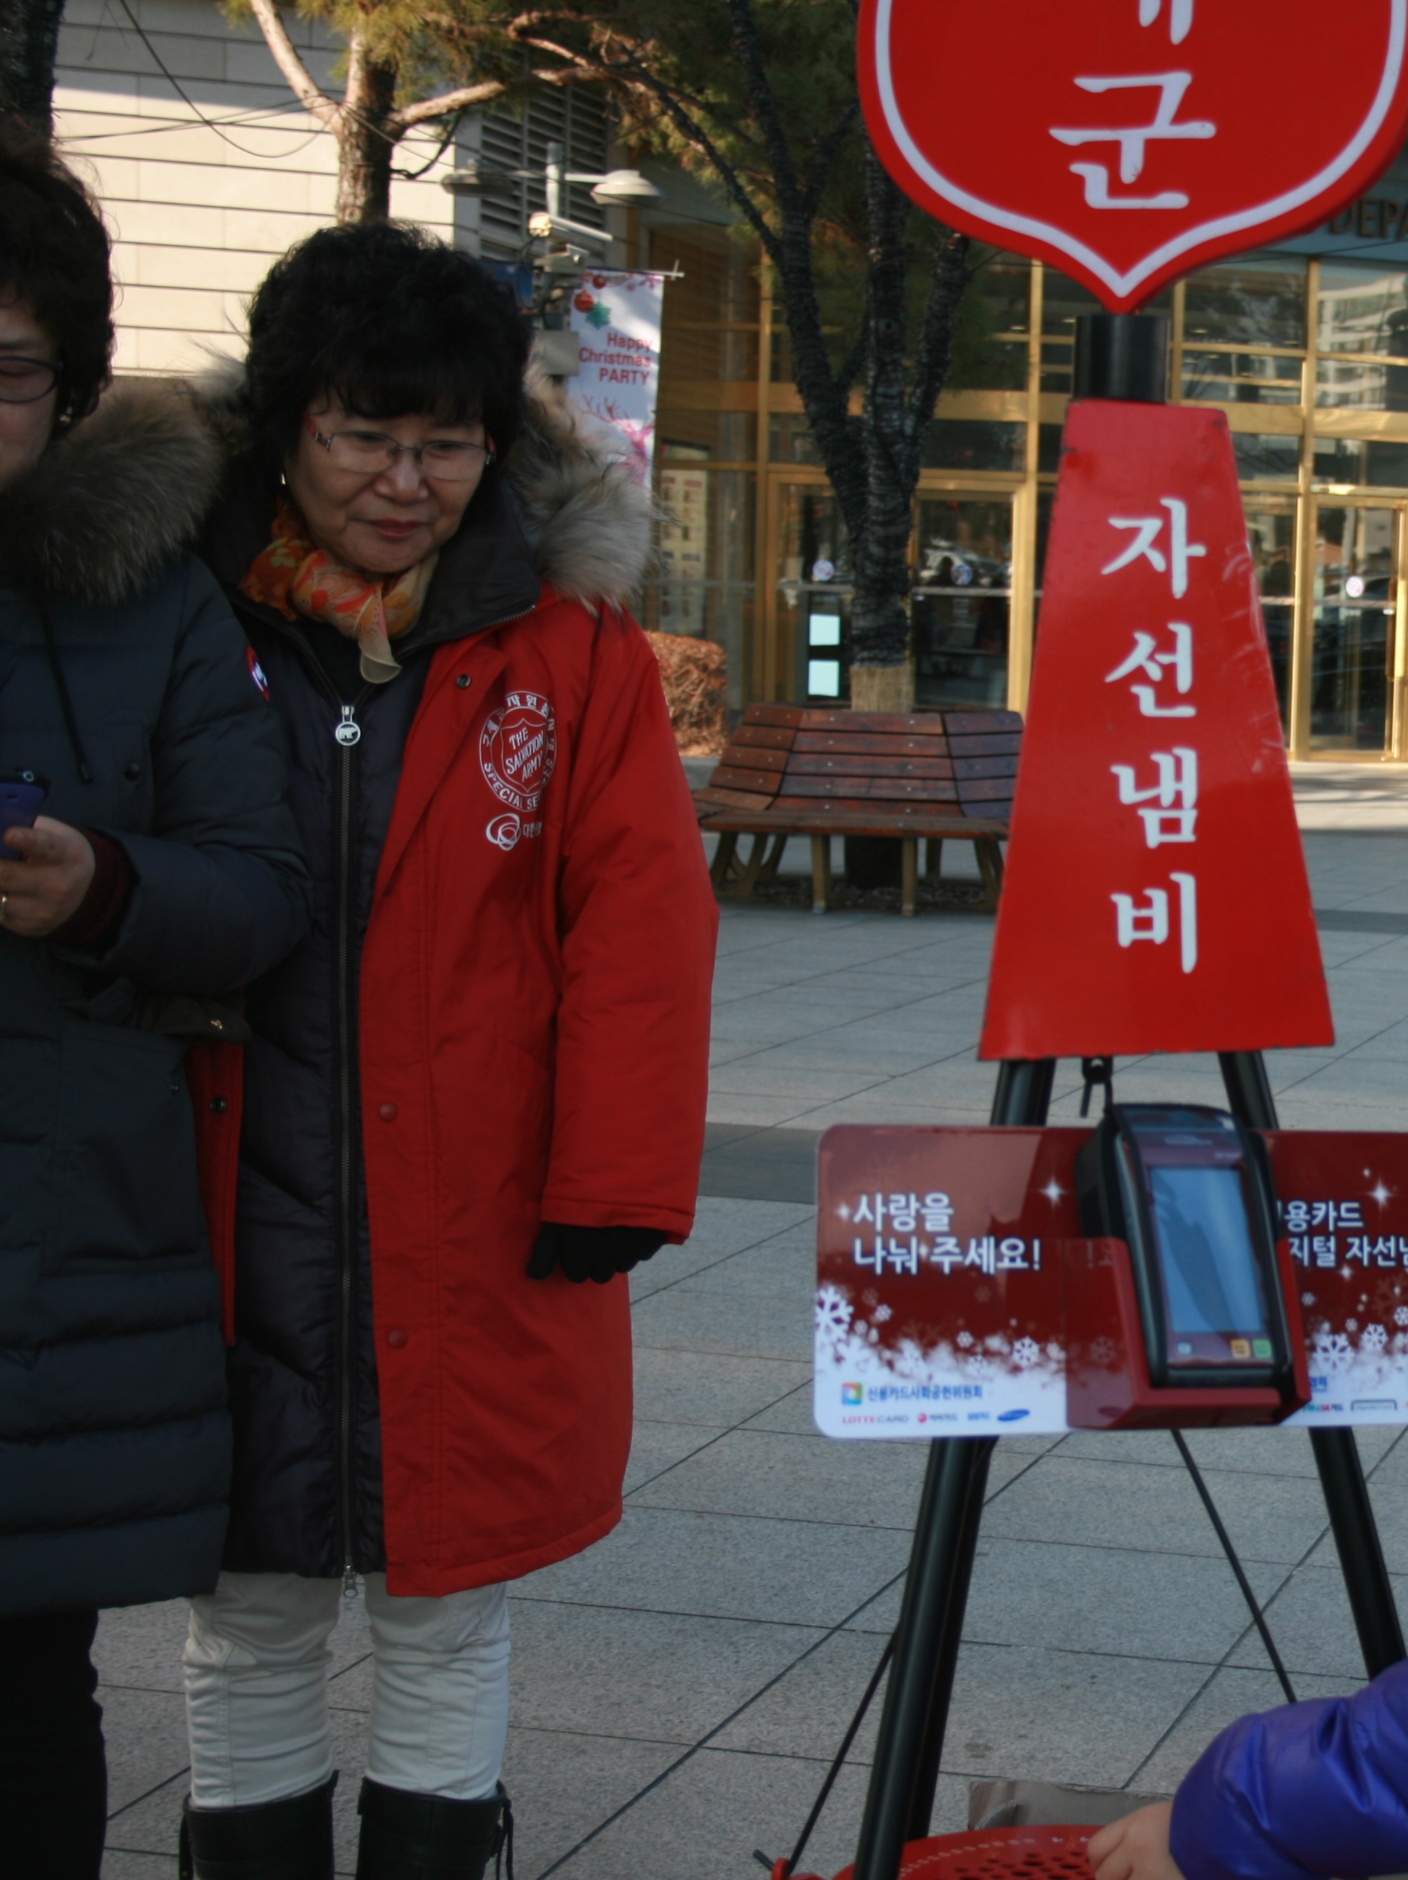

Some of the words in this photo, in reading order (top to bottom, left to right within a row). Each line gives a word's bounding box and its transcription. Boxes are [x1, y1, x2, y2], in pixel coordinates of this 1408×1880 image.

[1049, 0, 1216, 209] 군
[578, 346, 653, 368] Christmas
[607, 332, 654, 353] Happy
[599, 367, 650, 386] PARTY
[505, 730, 545, 775] SALVATION
[509, 726, 529, 750] THE
[1101, 497, 1207, 974] 자선냄비
[521, 751, 544, 783] ARMY
[484, 762, 523, 809] SPECIAL
[852, 1192, 955, 1233] 사랑을
[1277, 1199, 1365, 1233] 용카드
[853, 1235, 919, 1276] 나눠
[929, 1235, 1041, 1276] 주세요!
[1287, 1235, 1337, 1268] 지털
